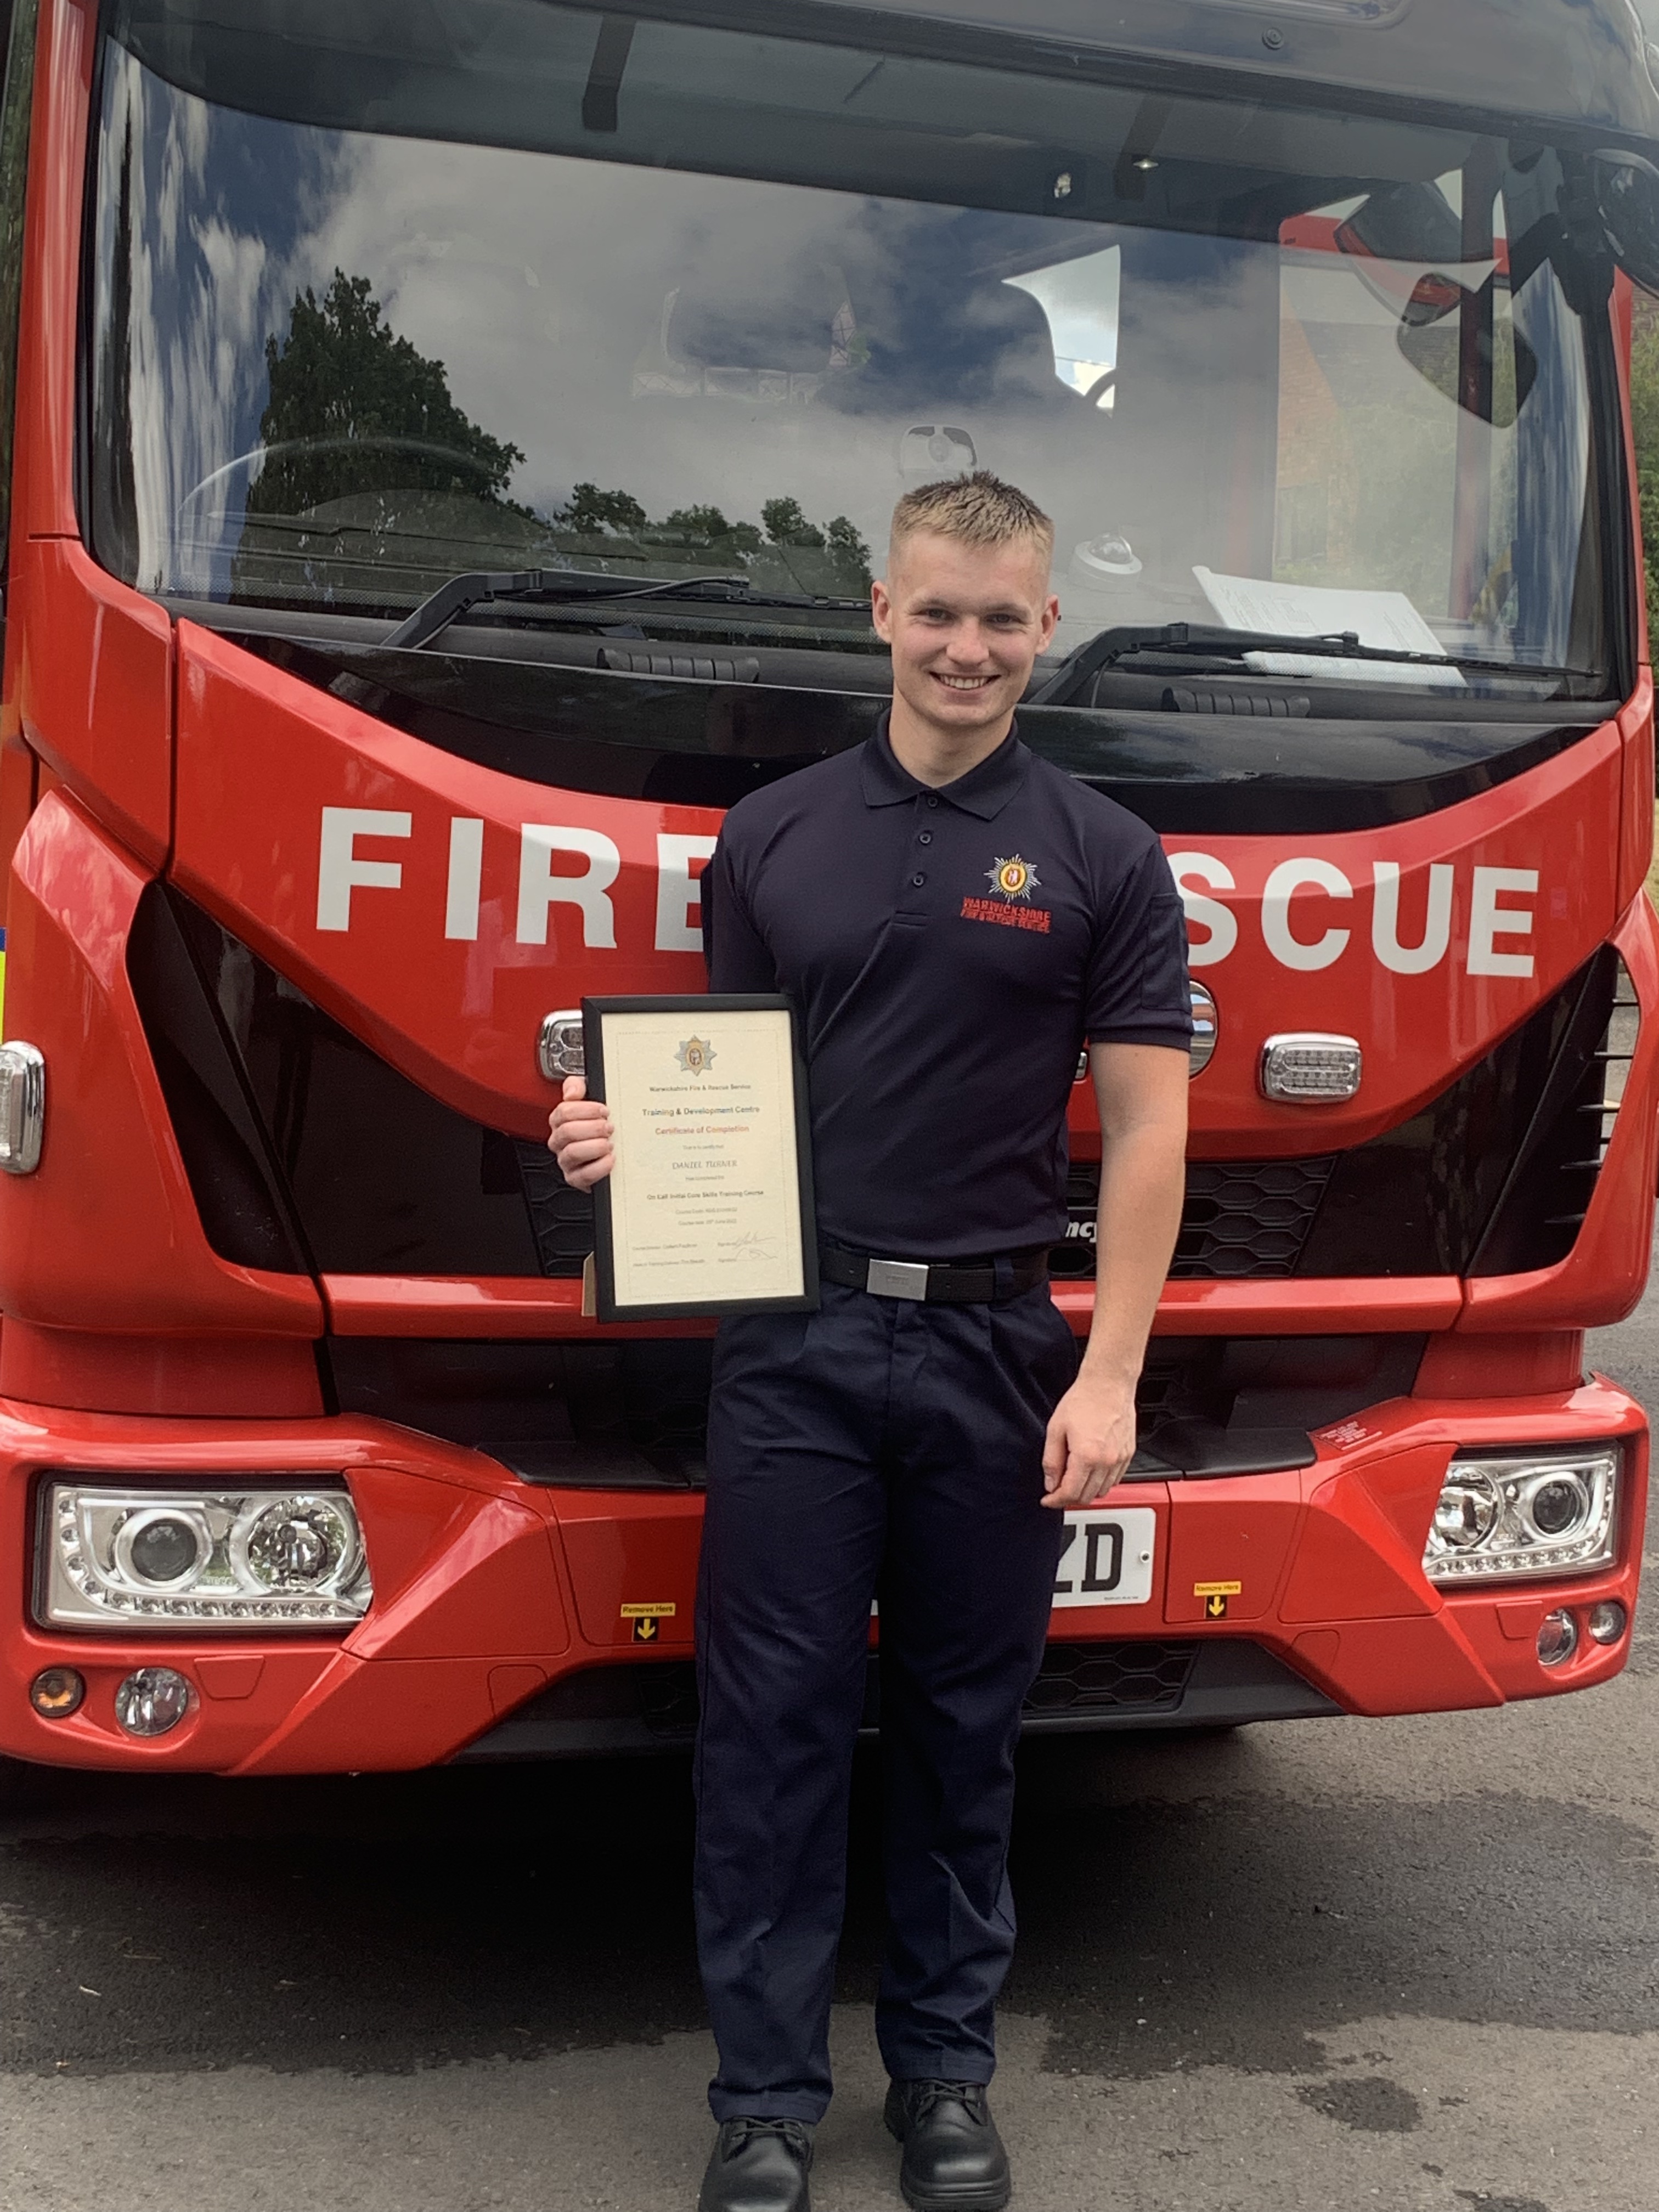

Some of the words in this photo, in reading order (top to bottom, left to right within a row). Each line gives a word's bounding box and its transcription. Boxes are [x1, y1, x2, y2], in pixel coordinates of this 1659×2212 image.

[317, 806, 718, 952] FIRE
[642, 1109, 674, 1117] Training
[684, 1106, 733, 1115] Development
[706, 1126, 749, 1134] Completion
[672, 1161, 703, 1170] DANIEL
[706, 1160, 737, 1168] TURNER
